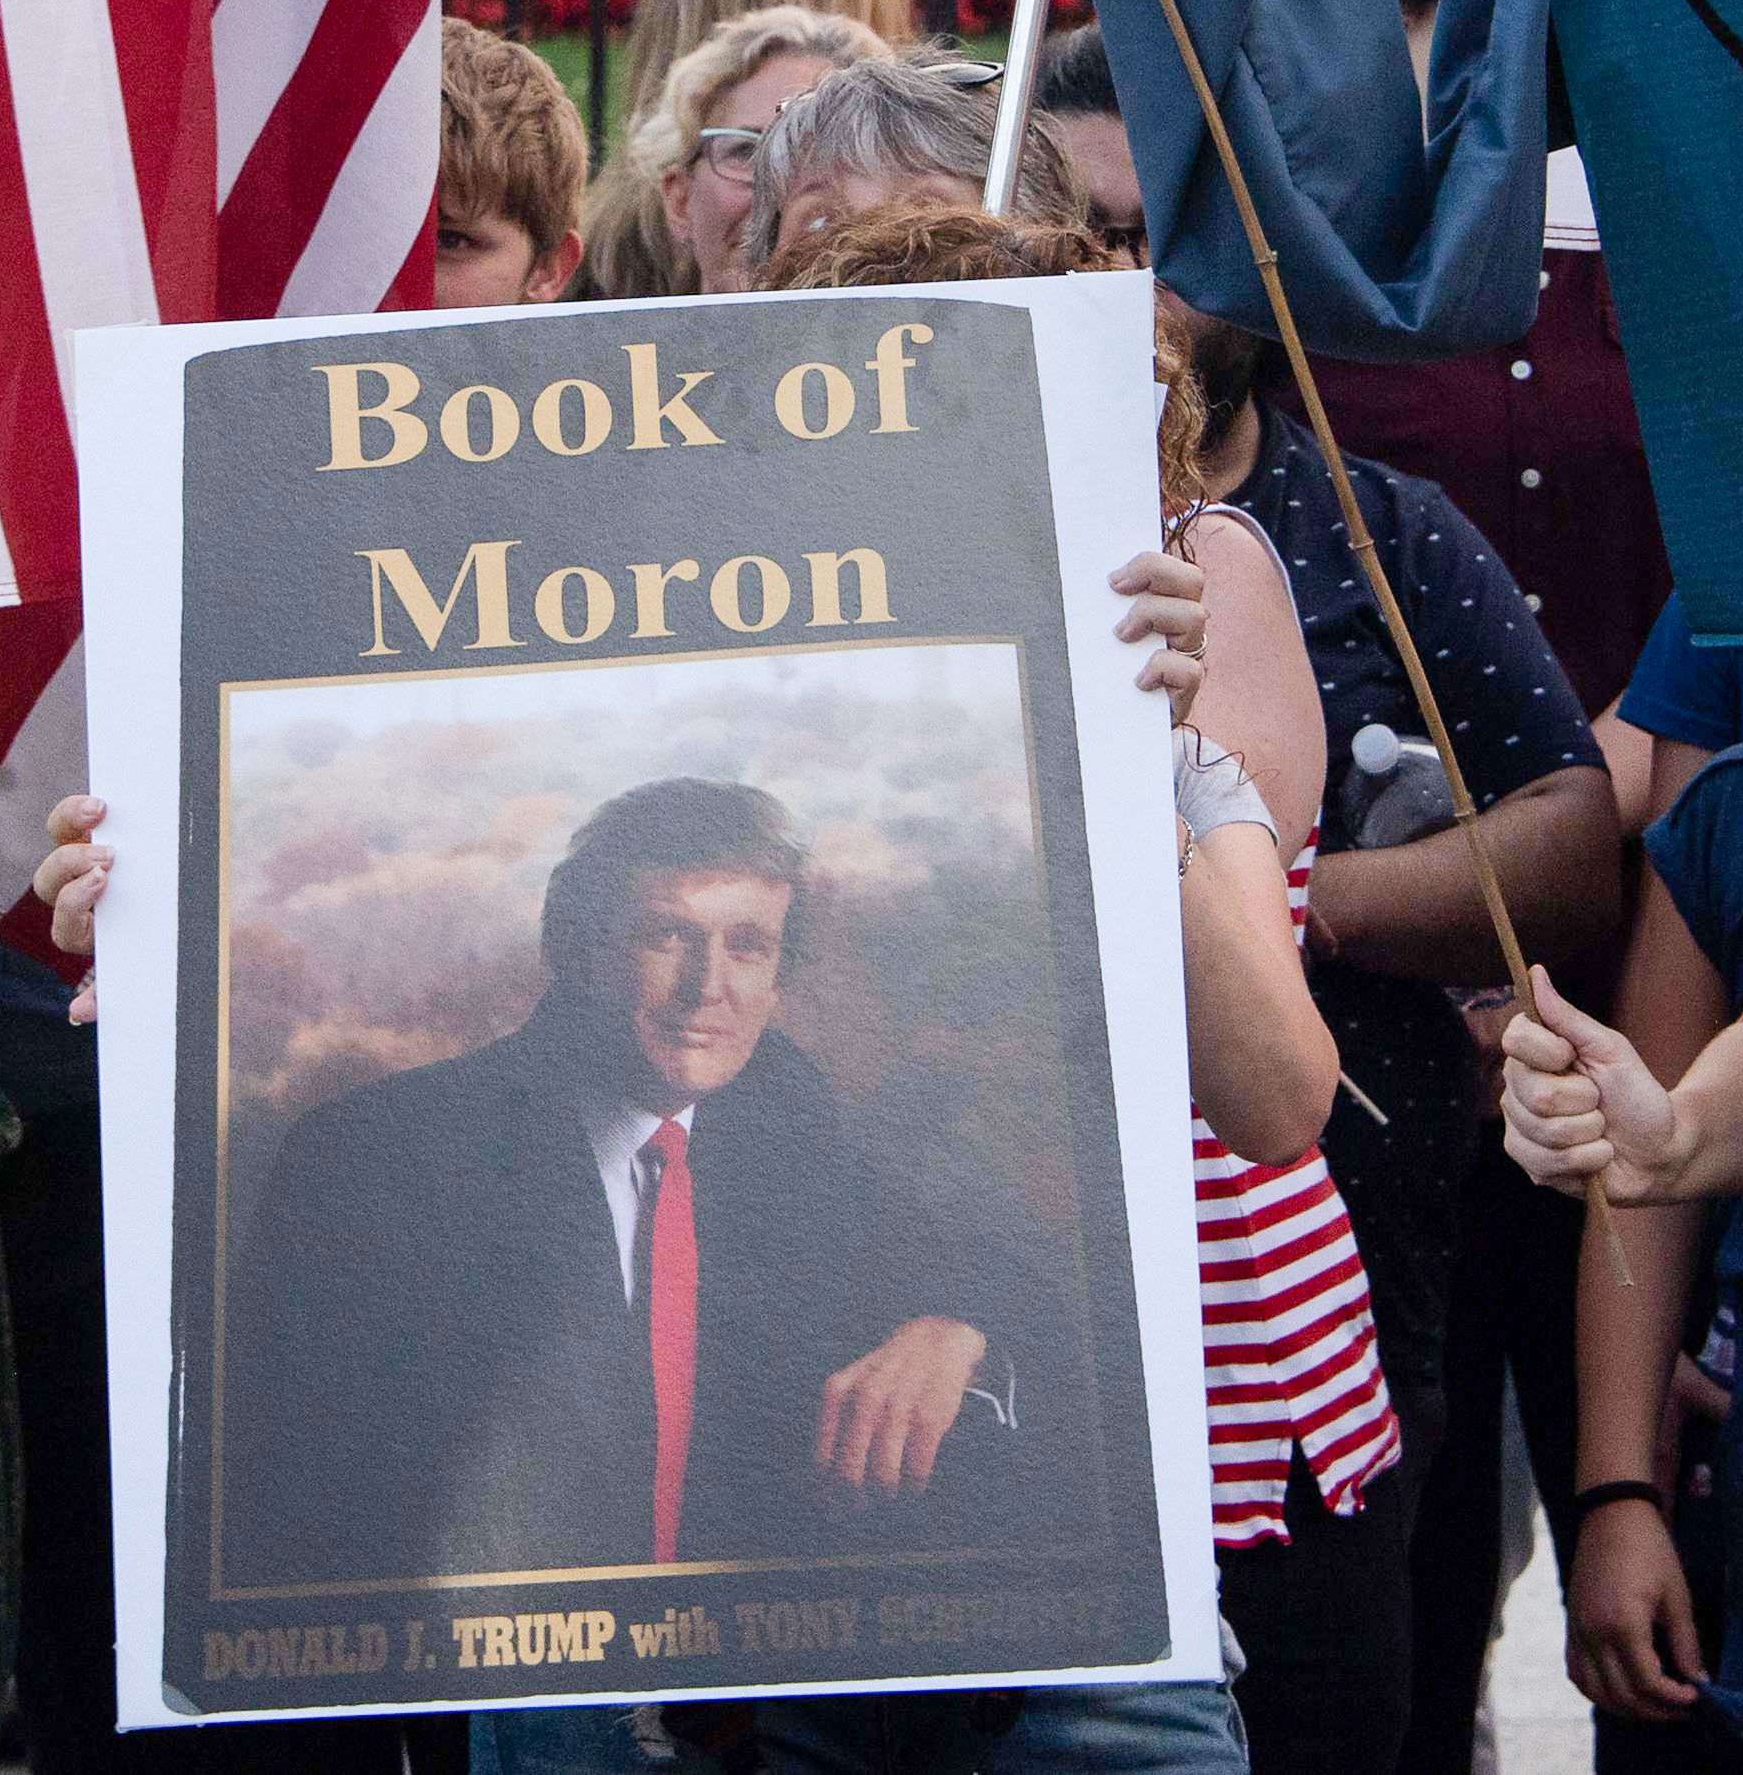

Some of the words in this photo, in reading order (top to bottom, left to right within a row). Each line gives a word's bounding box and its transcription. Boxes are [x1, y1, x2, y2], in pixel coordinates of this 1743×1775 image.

[311, 341, 726, 472] Book
[774, 322, 935, 441] of
[354, 539, 898, 657] Moron
[203, 1626, 389, 1681] DONALD
[404, 1620, 438, 1672] J.
[453, 1610, 616, 1669] TRUMP
[630, 1606, 721, 1659] with
[735, 1599, 859, 1652] TONY
